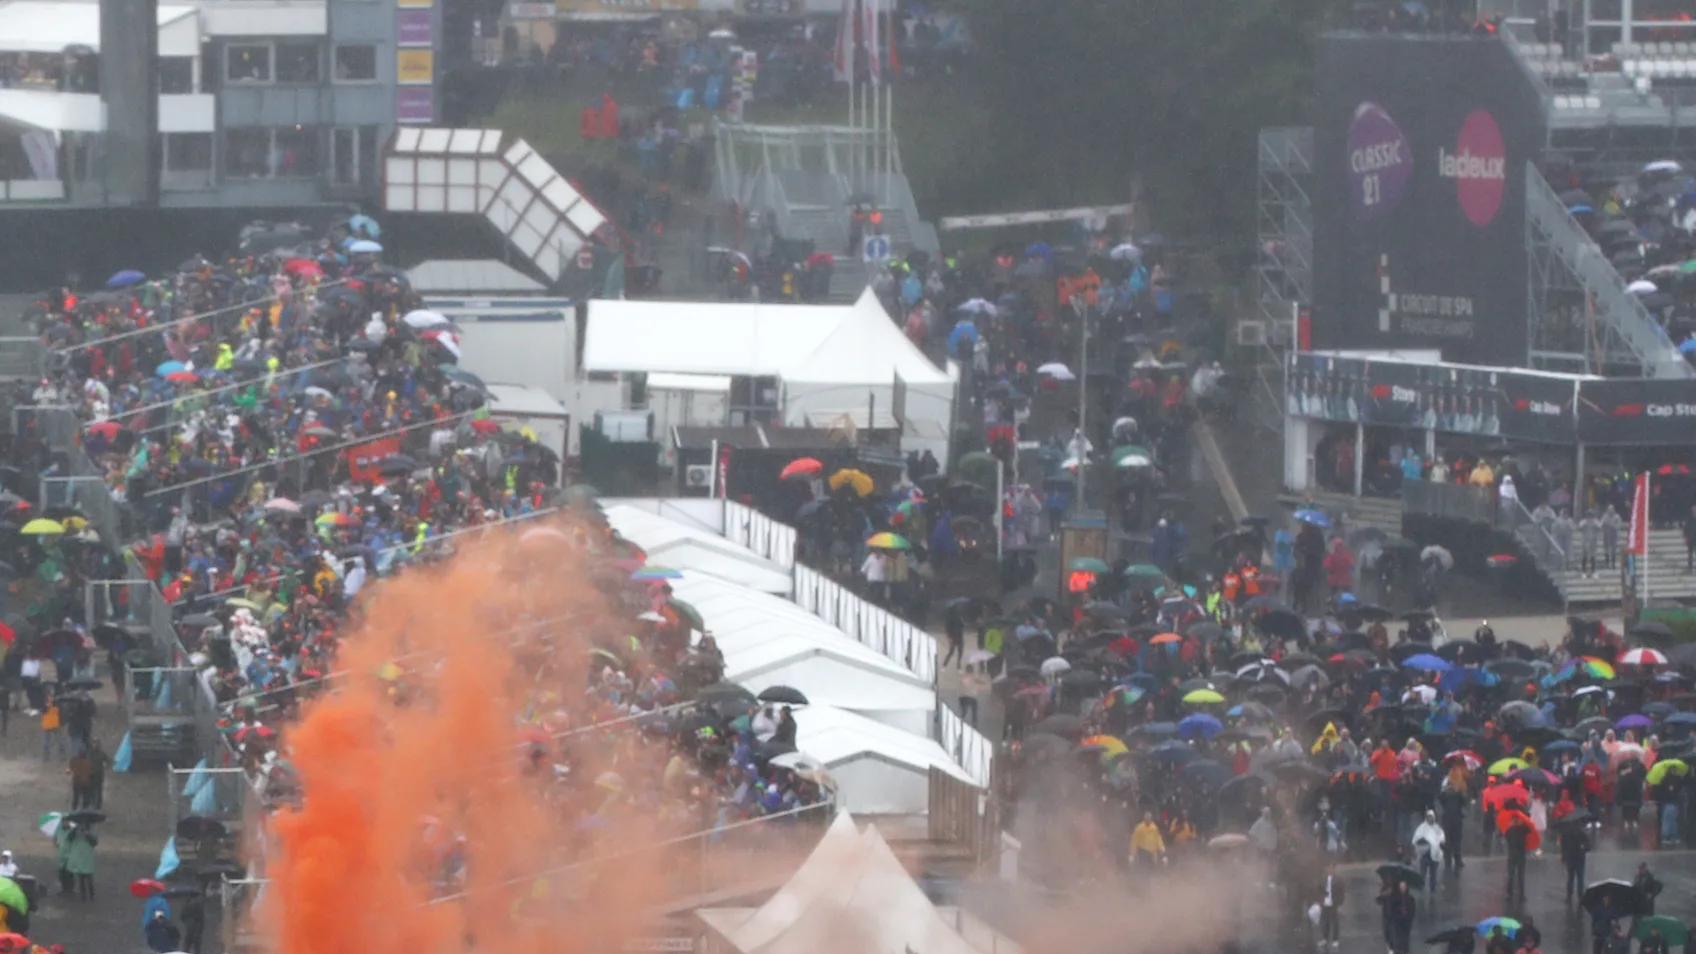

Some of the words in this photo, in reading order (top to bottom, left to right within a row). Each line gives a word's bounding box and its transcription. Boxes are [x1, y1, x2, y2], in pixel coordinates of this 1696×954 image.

[1351, 139, 1403, 173] CLASSIC
[1362, 173, 1381, 206] 21
[1647, 403, 1674, 418] Cap
